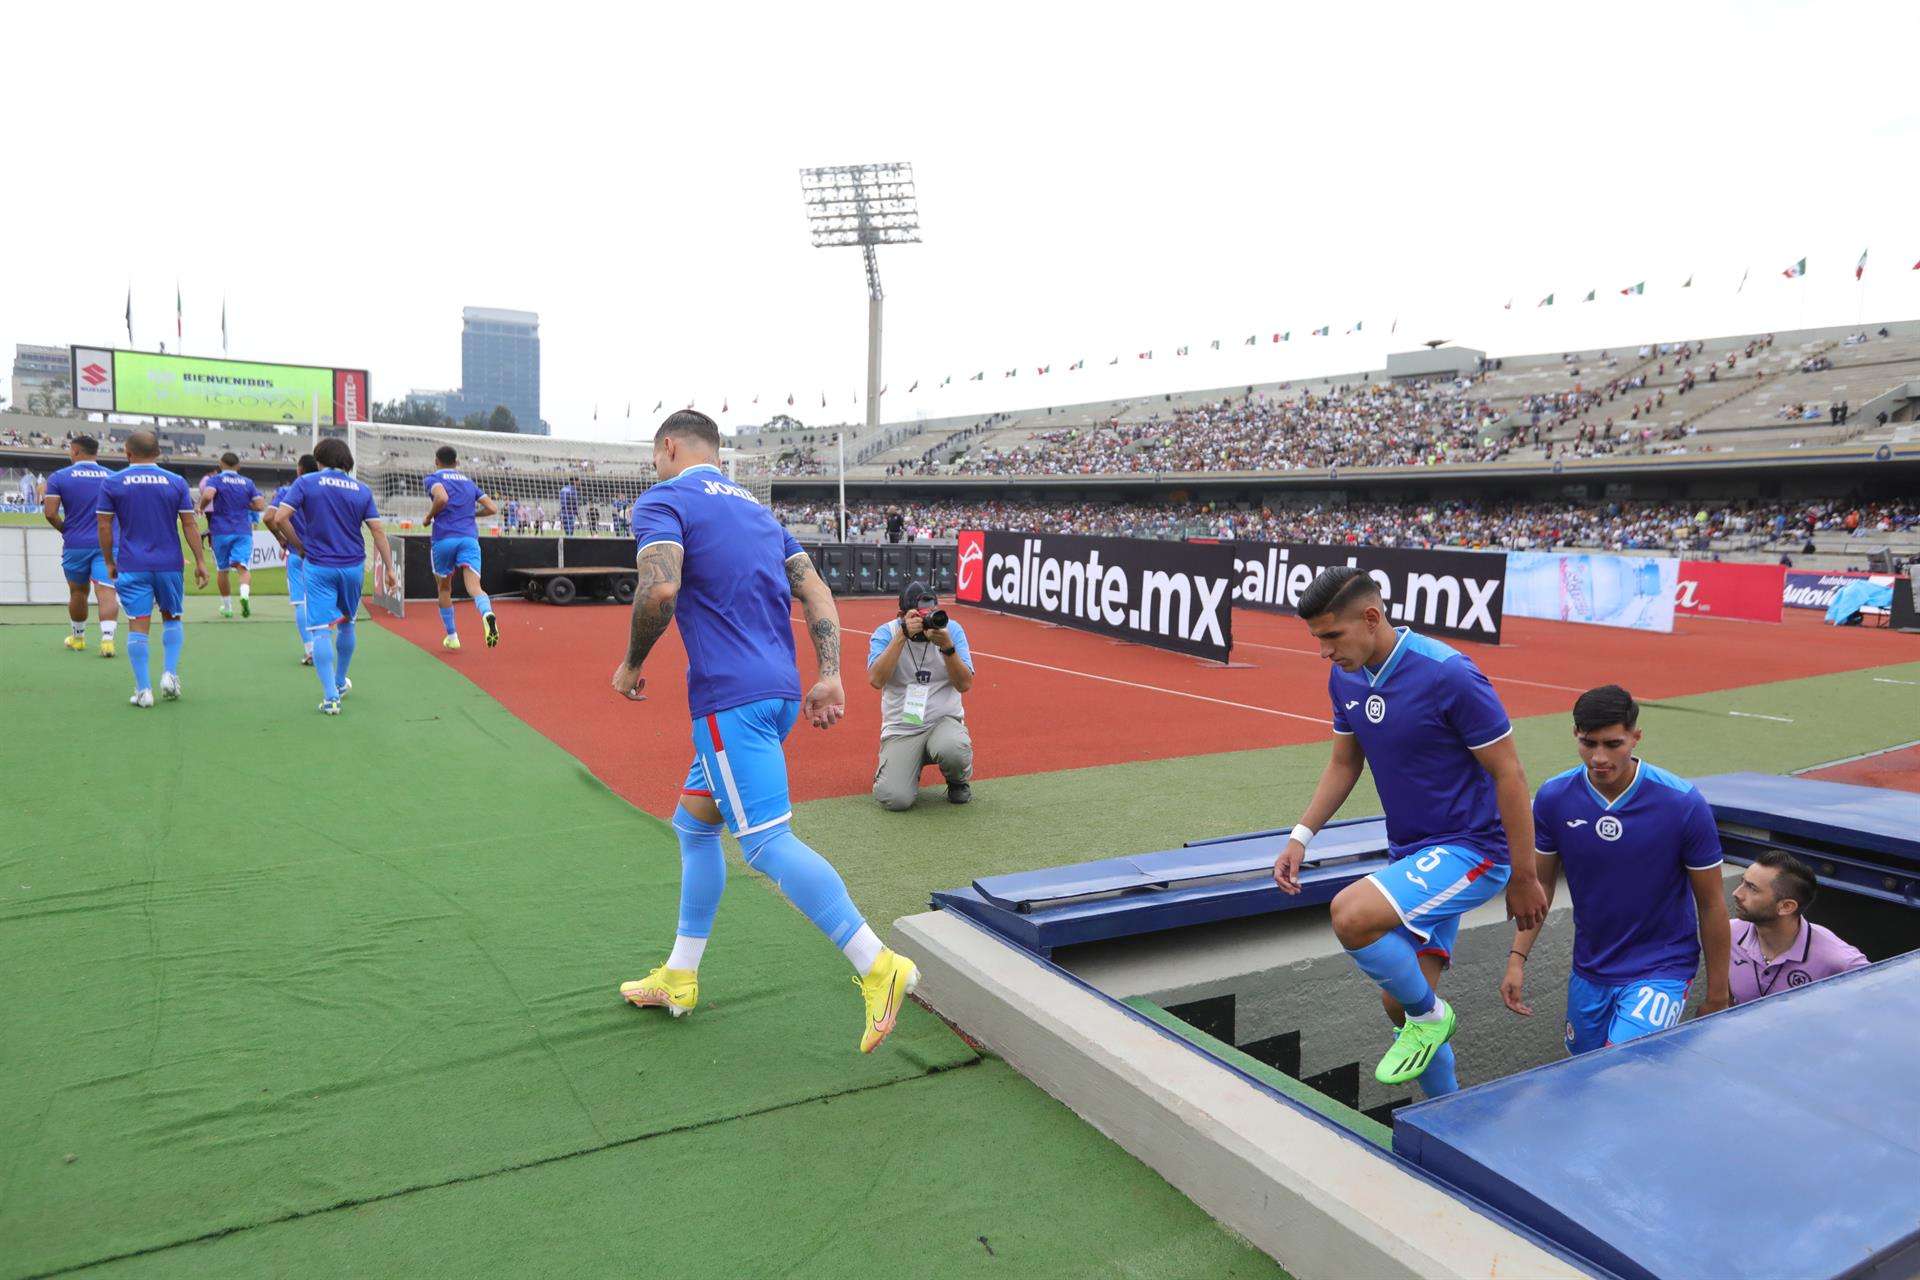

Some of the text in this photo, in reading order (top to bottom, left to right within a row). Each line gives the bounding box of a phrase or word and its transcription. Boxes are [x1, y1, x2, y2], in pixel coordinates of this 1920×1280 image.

[253, 546, 277, 564] BVA
[985, 538, 1229, 647] caliente.mx
[1232, 548, 1500, 633] caliee.mx
[1415, 847, 1450, 872] 5
